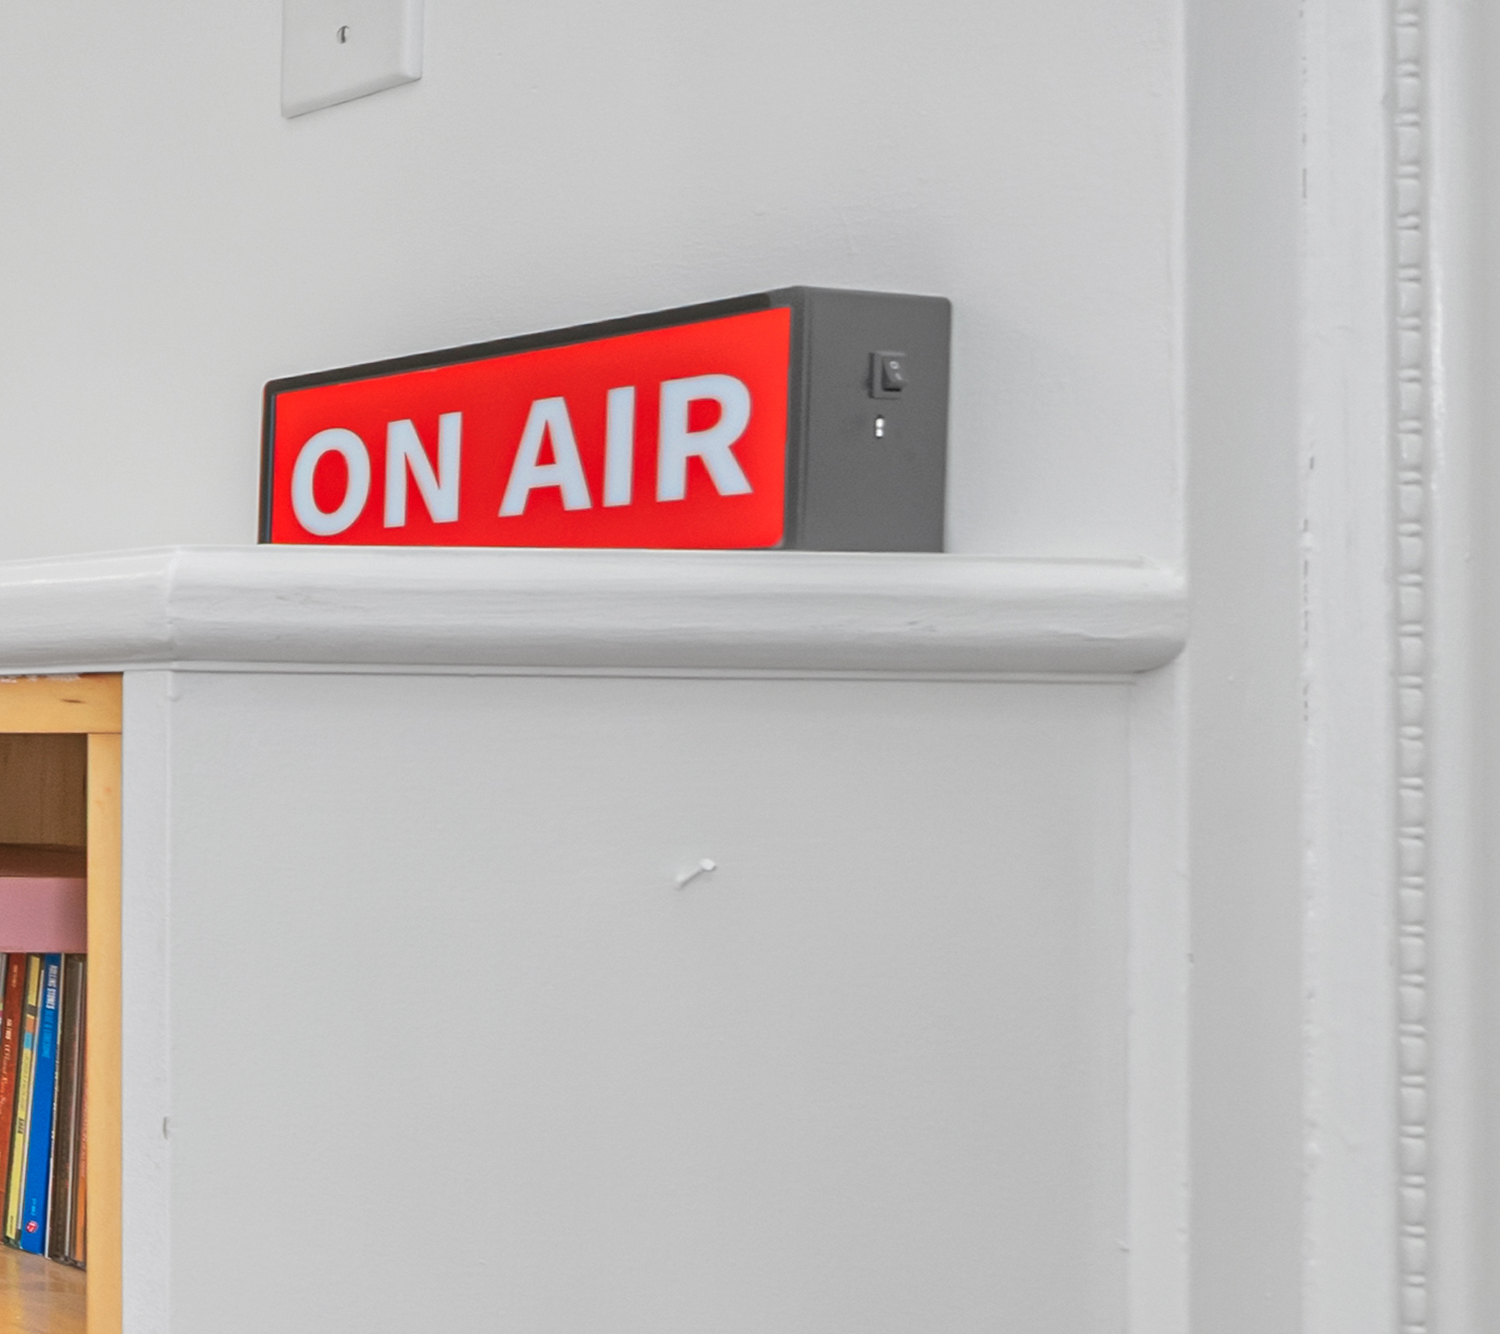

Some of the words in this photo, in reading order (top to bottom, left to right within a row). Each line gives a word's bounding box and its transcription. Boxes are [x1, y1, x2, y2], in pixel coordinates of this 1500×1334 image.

[290, 411, 463, 537] ON
[498, 373, 754, 518] AIR
[46, 964, 58, 987] ROLLING
[45, 987, 57, 1010] STONES
